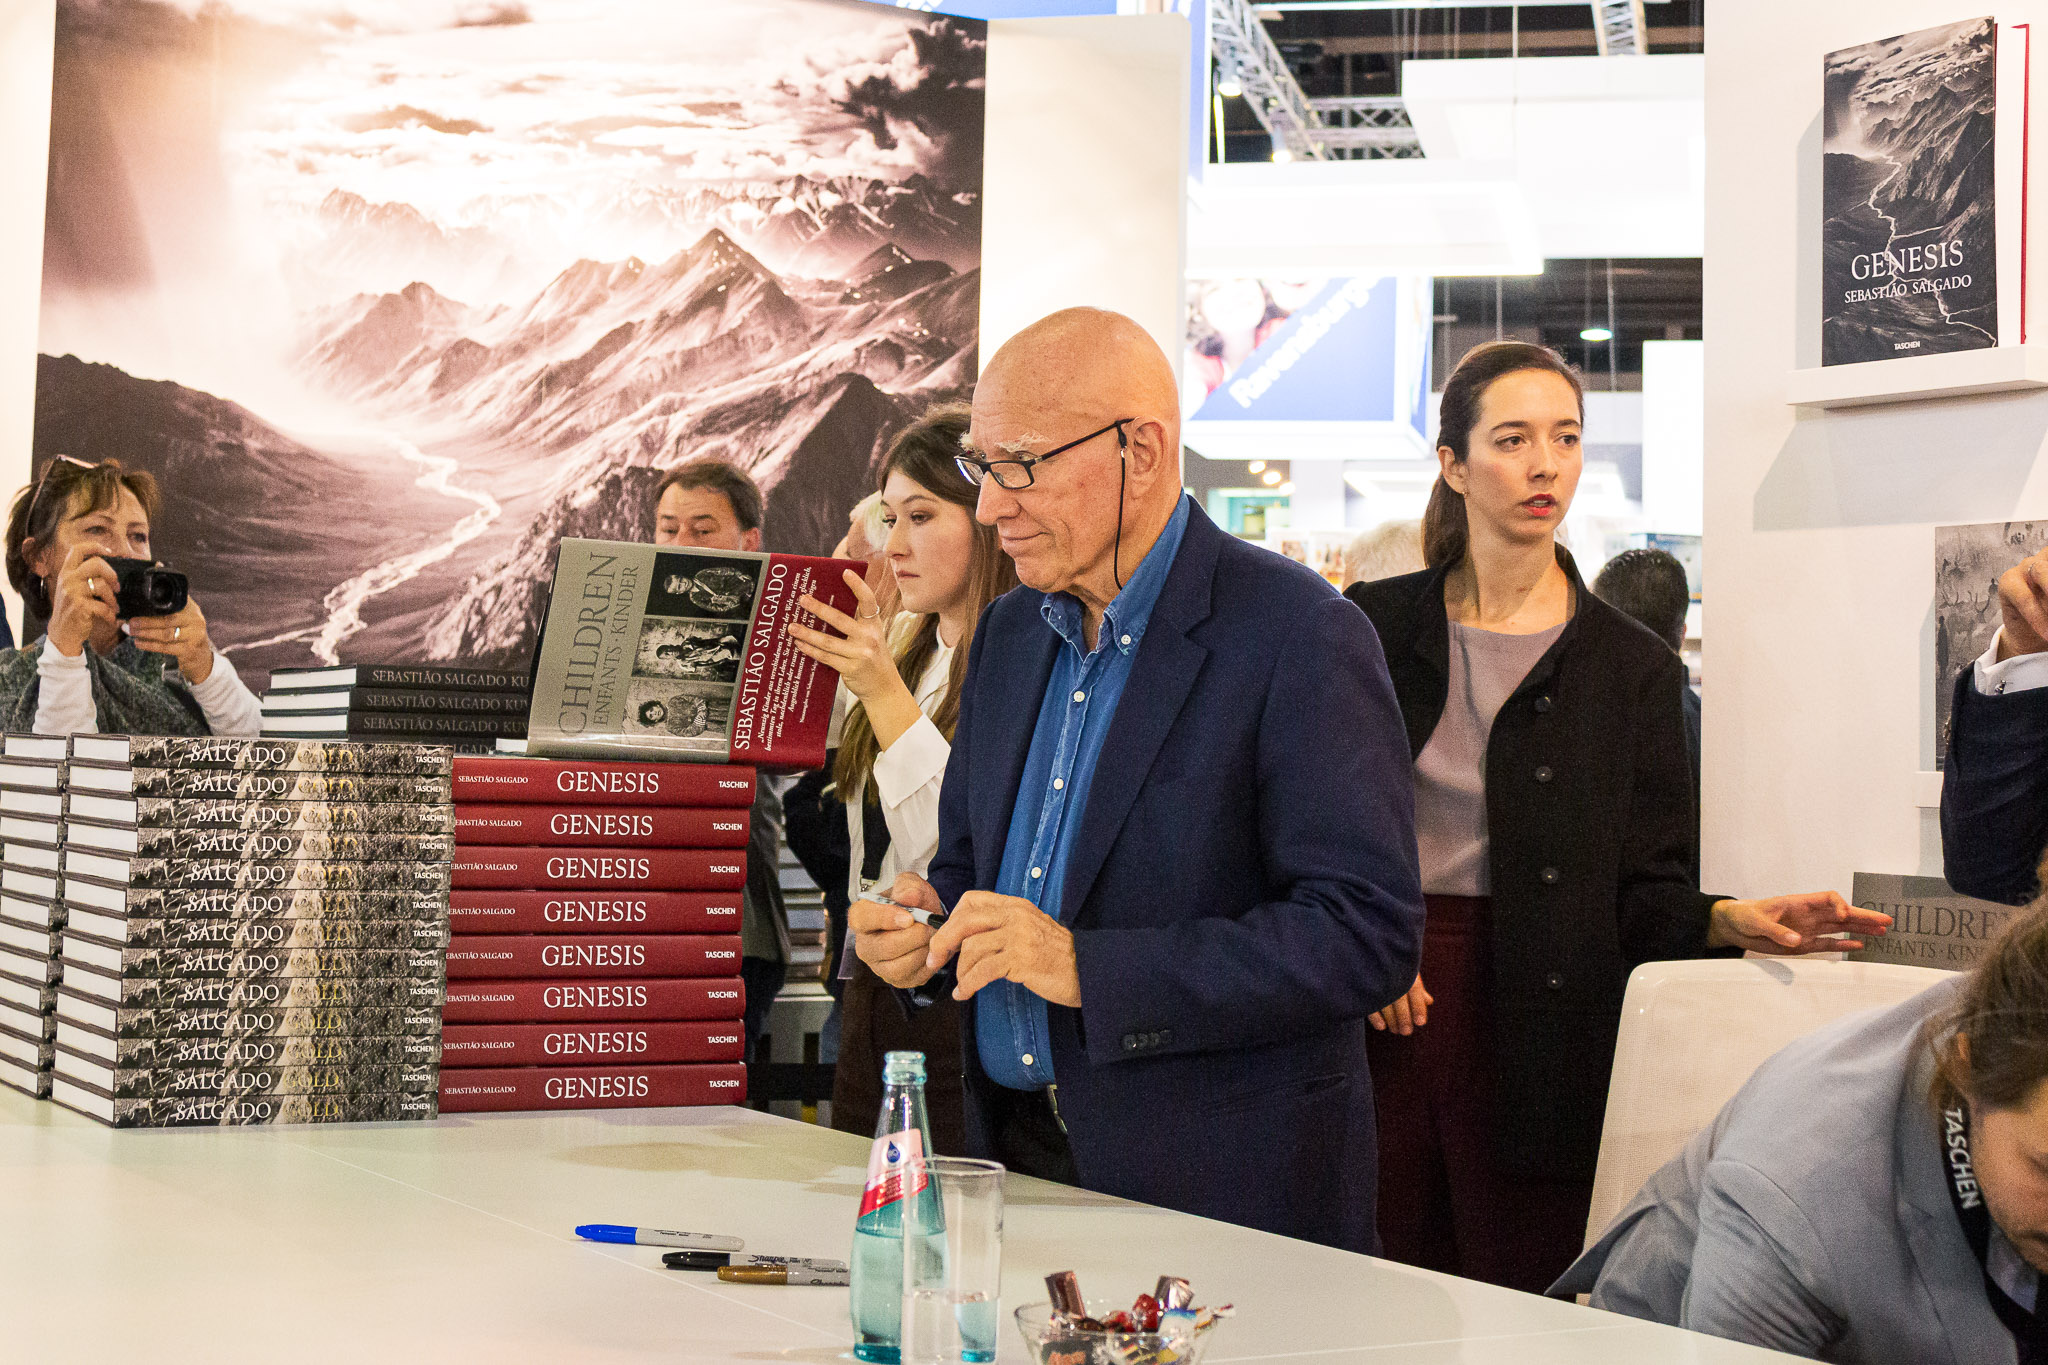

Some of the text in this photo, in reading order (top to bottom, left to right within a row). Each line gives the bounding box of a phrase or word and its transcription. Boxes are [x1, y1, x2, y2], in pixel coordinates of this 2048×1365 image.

[1851, 240, 1964, 281] GENESIS
[1912, 275, 1972, 295] SALGADO
[1894, 341, 1920, 350] TASCHEN
[559, 552, 619, 735] CHILDREN
[593, 565, 640, 726] ENFANTS KINDER
[735, 563, 788, 750] SEBASTIÃO SALGADO
[445, 671, 506, 687] SALGADO
[438, 697, 500, 711] SALGADO
[436, 719, 498, 733] SALGADO
[192, 747, 286, 763] SALGADO
[415, 756, 445, 764] TASCHEN
[194, 777, 286, 793] SALGADO
[415, 785, 444, 793] TASCHEN
[496, 776, 529, 784] SALGADO
[557, 770, 659, 794] GENESIS
[719, 780, 749, 789] TASCHEN
[198, 807, 291, 823] SALGADO
[419, 814, 448, 822] TASCHEN
[550, 813, 654, 836] GENESIS
[713, 823, 743, 831] TASCHEN
[199, 836, 292, 852] SALGADO
[419, 842, 448, 850] TASCHEN
[192, 865, 286, 882] SALGADO
[485, 863, 518, 871] SALGADO
[546, 857, 650, 880] GENESIS
[710, 865, 740, 874] TASCHEN
[188, 896, 283, 912] SALGADO
[412, 901, 442, 909] TASCHEN
[544, 901, 647, 923] GENESIS
[706, 907, 736, 916] TASCHEN
[189, 925, 284, 942] SALGADO
[413, 930, 443, 938] TASCHEN
[184, 955, 279, 972] SALGADO
[409, 959, 438, 967] TASCHEN
[480, 952, 513, 960] SALGADO
[541, 945, 645, 967] GENESIS
[705, 951, 735, 960] TASCHEN
[184, 984, 280, 1001] SALGADO
[481, 994, 515, 1002] SALGADO
[543, 986, 647, 1008] GENESIS
[708, 991, 738, 999] TASCHEN
[180, 1014, 275, 1031] SALGADO
[180, 1043, 275, 1060] SALGADO
[481, 1041, 515, 1049] SALGADO
[544, 1031, 648, 1055] GENESIS
[708, 1035, 738, 1044] TASCHEN
[177, 1072, 272, 1090] SALGADO
[402, 1074, 431, 1082] TASCHEN
[482, 1086, 516, 1094] SALGADO
[545, 1075, 649, 1100] GENESIS
[709, 1080, 740, 1088] TASCHEN
[177, 1102, 271, 1119] SALGADO
[1945, 1107, 1982, 1209] TASCHEN
